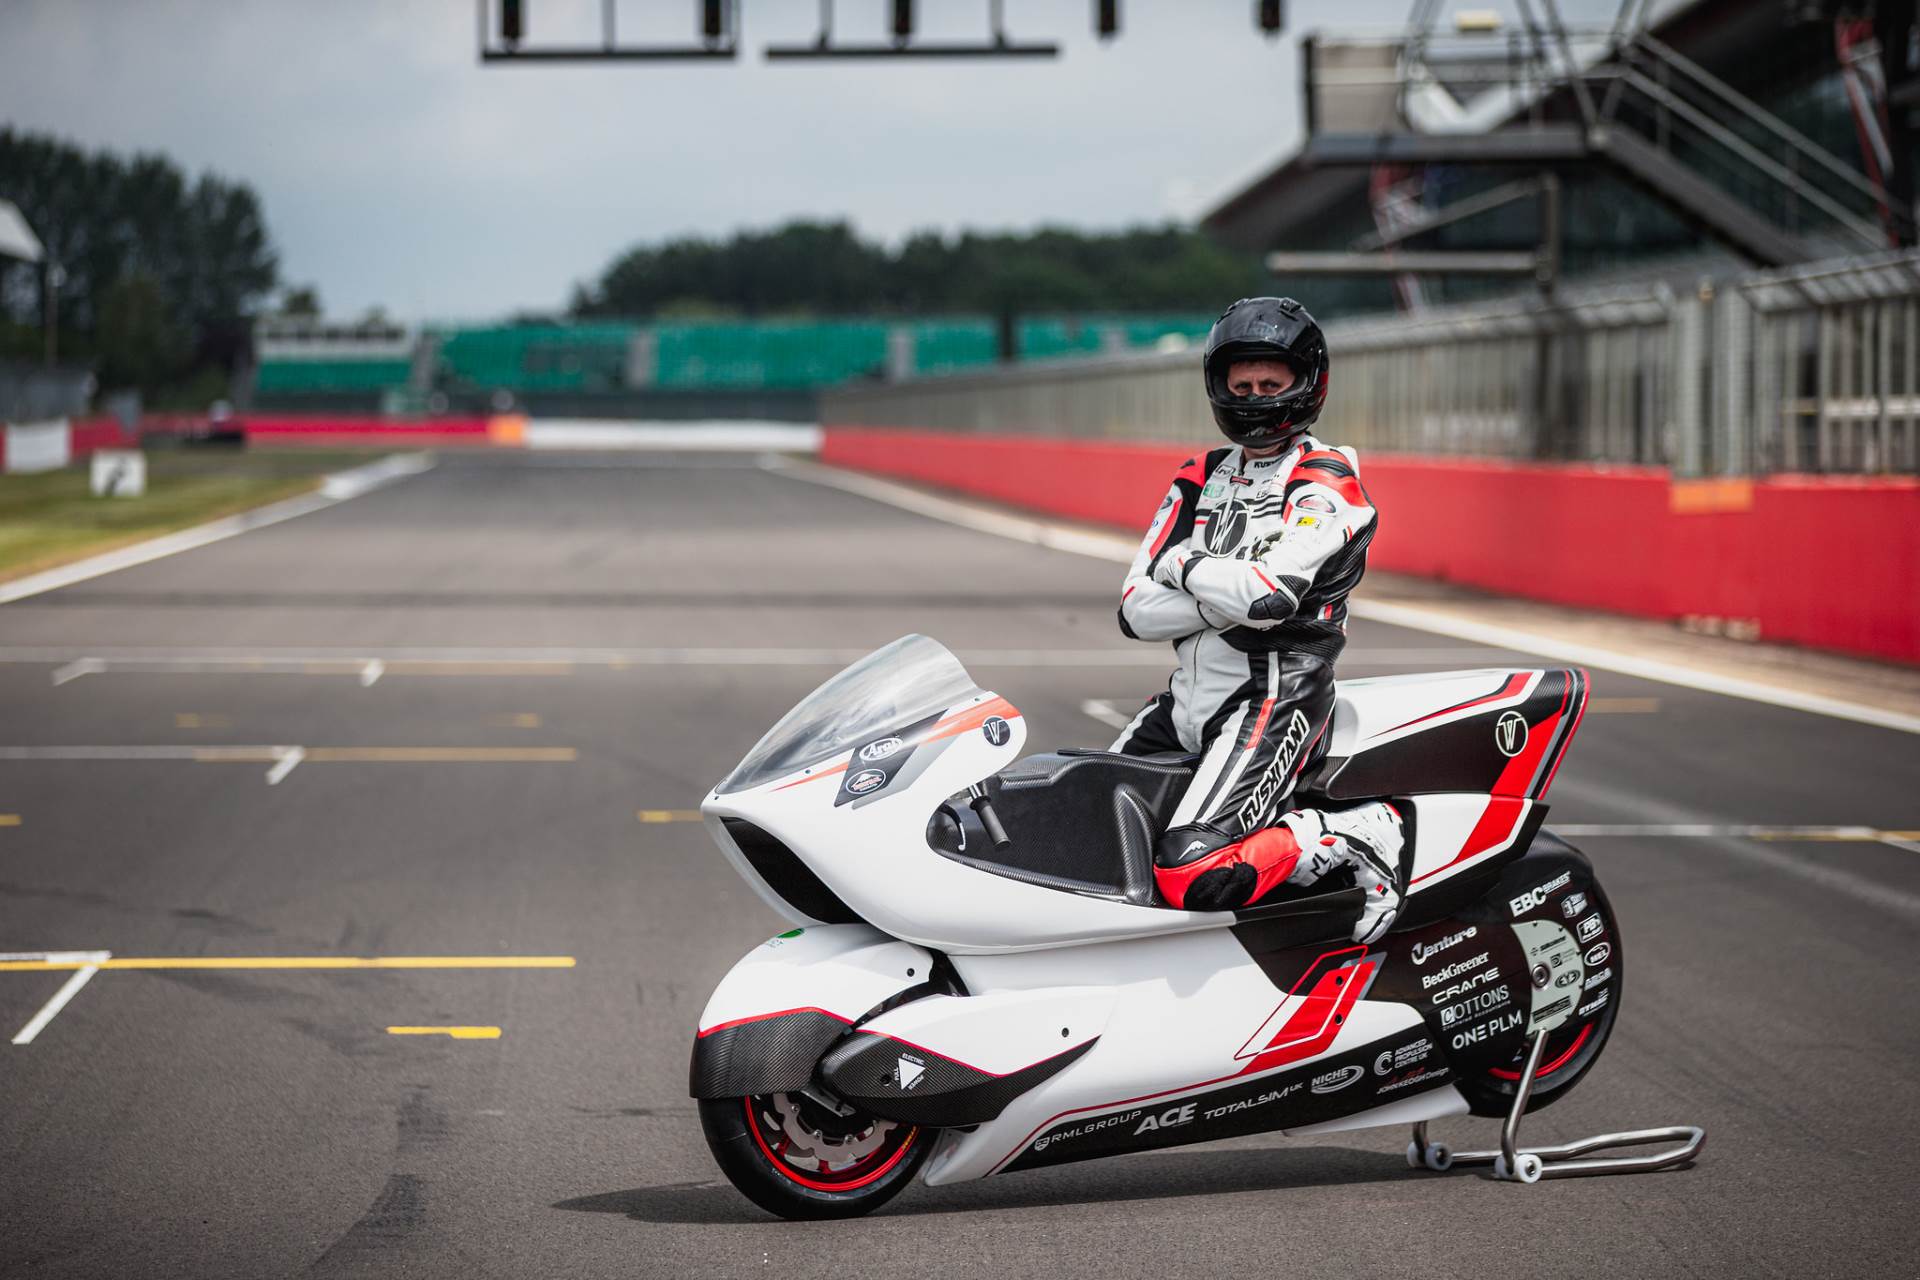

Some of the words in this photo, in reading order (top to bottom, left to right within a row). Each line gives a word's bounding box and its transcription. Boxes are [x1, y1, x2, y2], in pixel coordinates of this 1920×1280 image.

[865, 739, 902, 758] Arai
[1509, 886, 1547, 917] EBC
[1411, 926, 1477, 965] Venture
[1422, 952, 1489, 989] BeckGreener
[1432, 967, 1500, 1004] CRANE
[1440, 985, 1510, 1026] COTTONS
[1452, 1024, 1488, 1049] ONE
[1489, 1010, 1522, 1036] PLM
[1311, 1069, 1349, 1086] NICHE
[1133, 1103, 1198, 1135] ACE
[1204, 1088, 1290, 1119] TOTALSIM
[1289, 1082, 1304, 1092] UK
